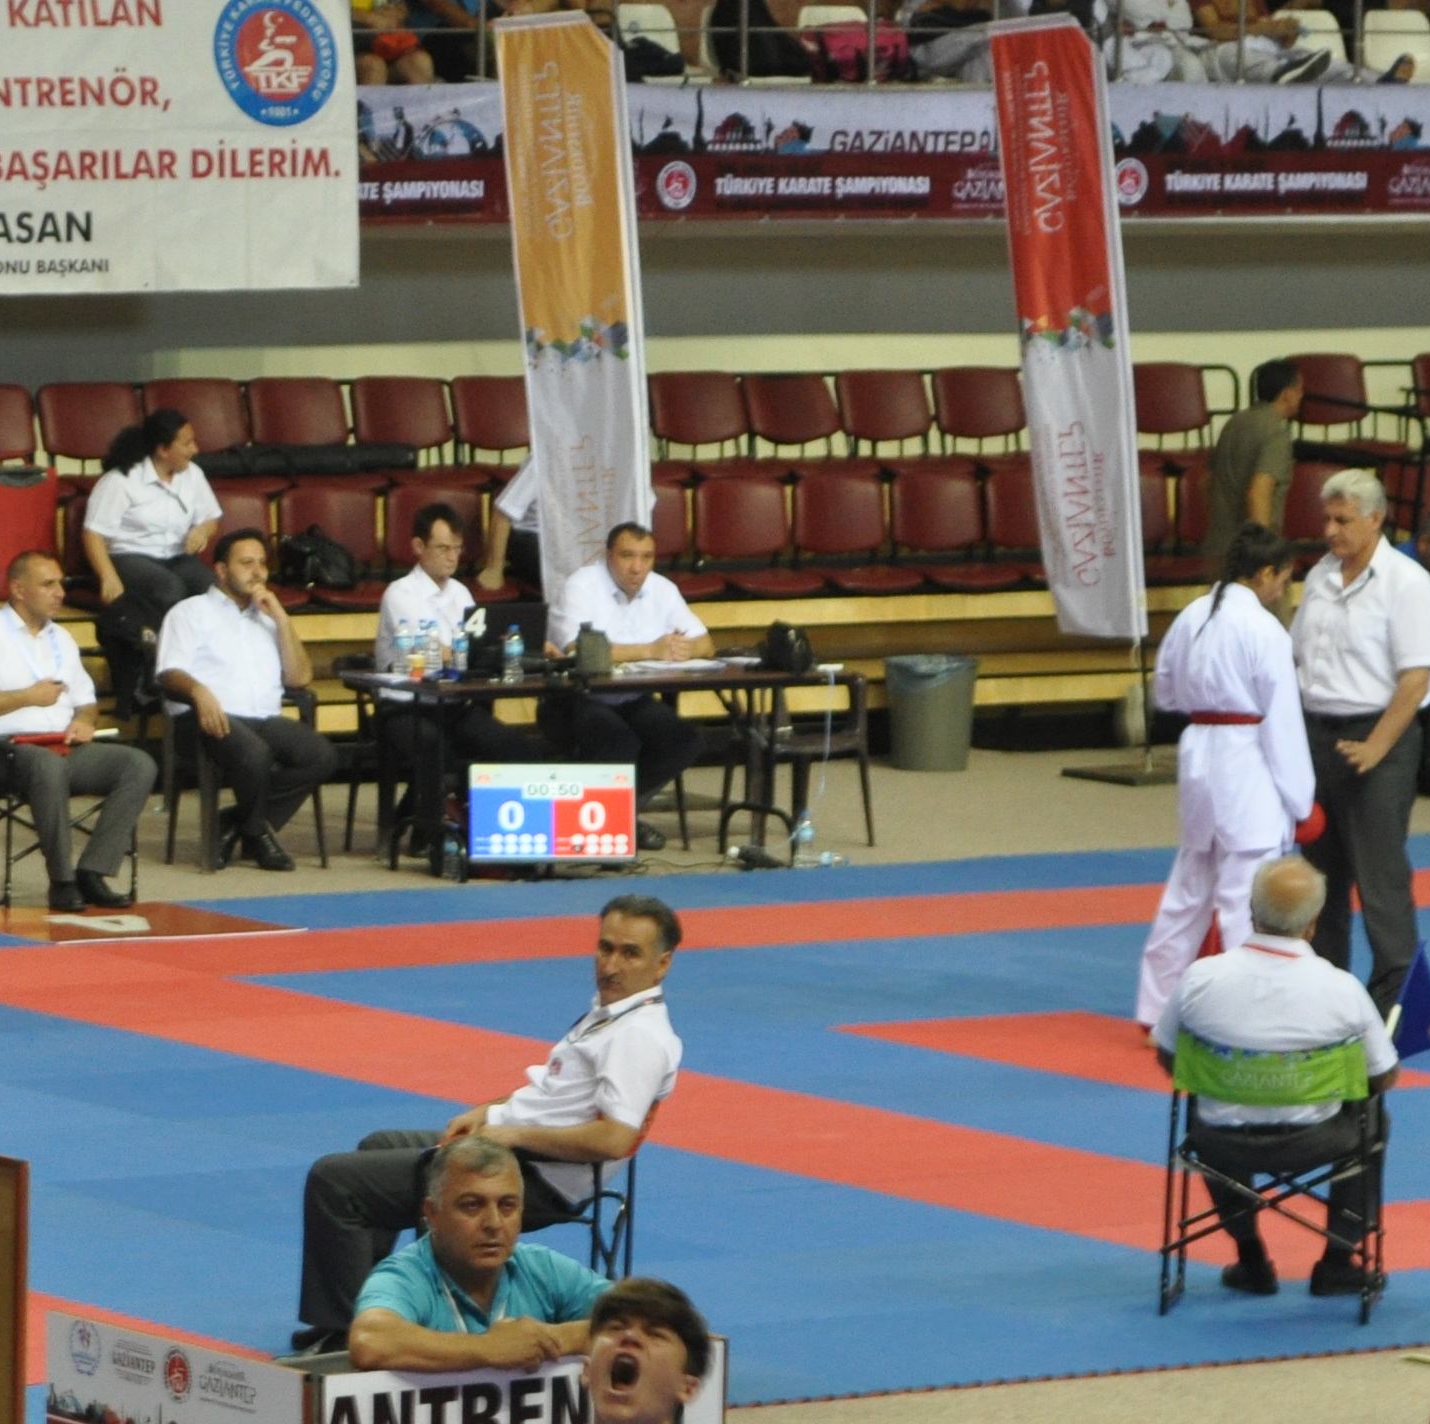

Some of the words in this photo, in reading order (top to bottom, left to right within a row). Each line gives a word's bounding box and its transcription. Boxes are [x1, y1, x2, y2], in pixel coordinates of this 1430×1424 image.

[9, 0, 162, 27] KATILAN
[254, 66, 312, 90] TKF
[190, 138, 341, 179] DİLERİM.
[777, 176, 833, 194] KARATE
[36, 258, 109, 278] BAŞKANI
[464, 607, 487, 638] 4
[497, 801, 525, 831] 0
[578, 801, 606, 831] 0
